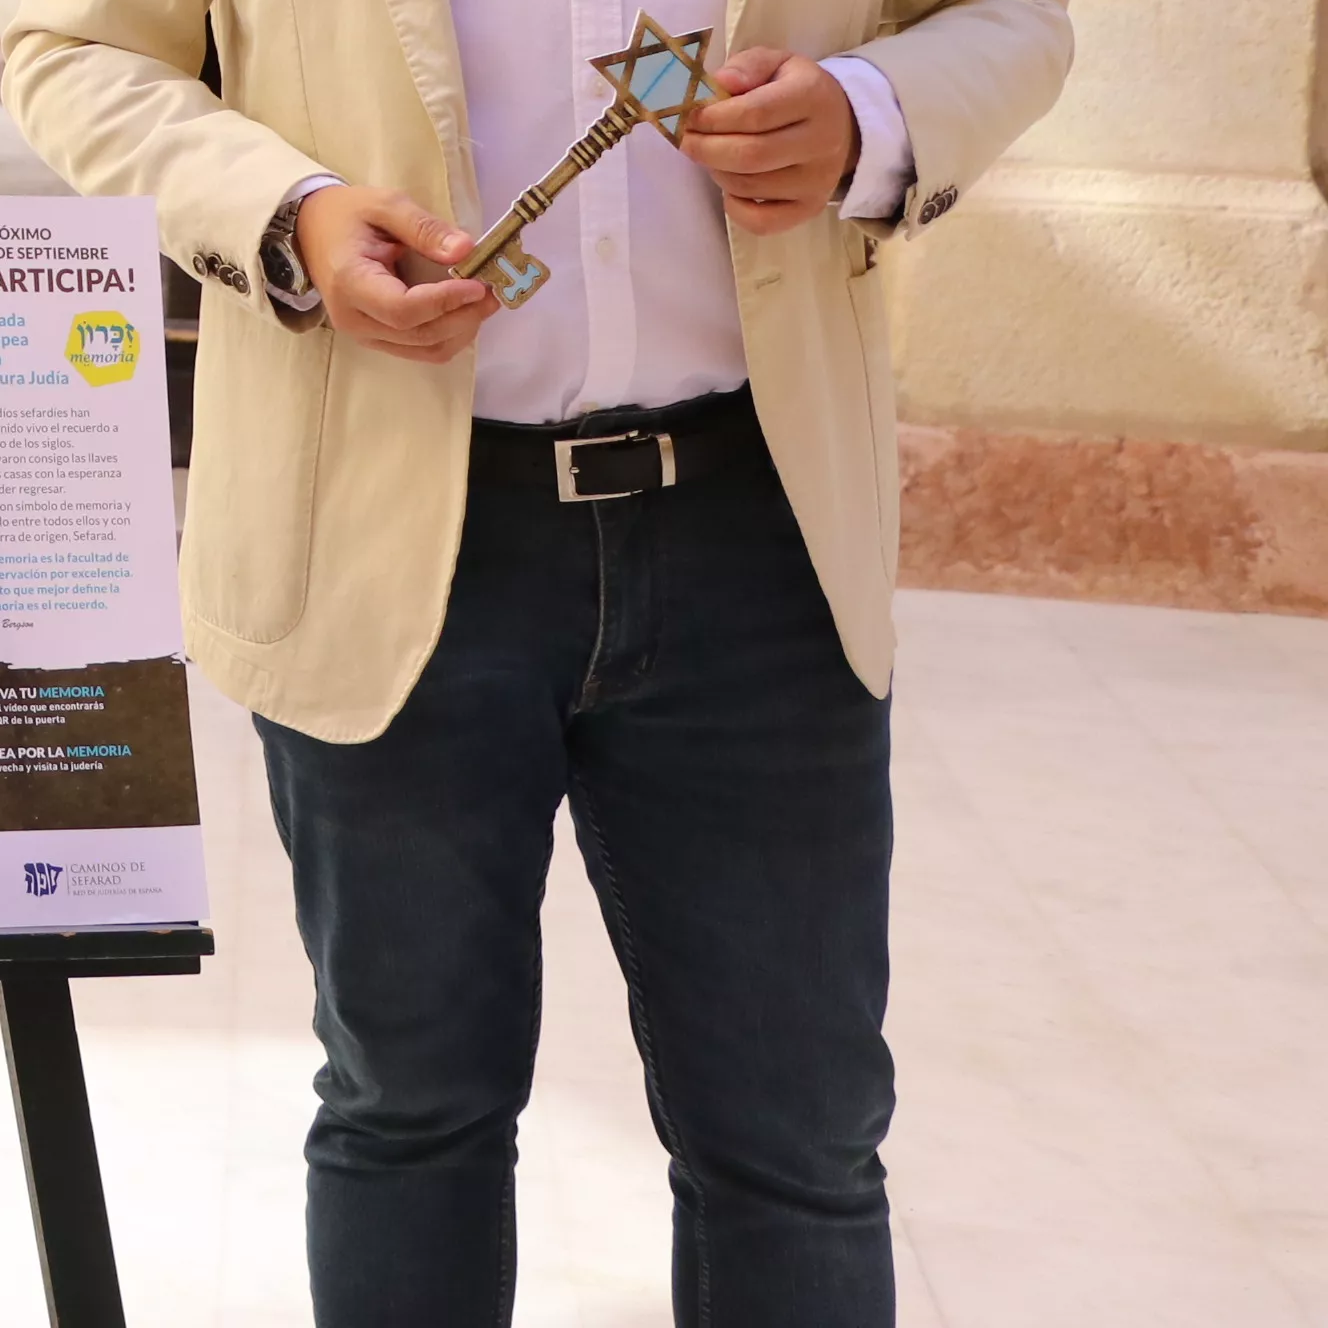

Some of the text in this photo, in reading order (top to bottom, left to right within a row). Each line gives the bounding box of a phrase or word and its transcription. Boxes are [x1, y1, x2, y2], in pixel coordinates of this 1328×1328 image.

[17, 246, 109, 260] SEPTIEMBRE
[70, 352, 134, 366] memoria
[28, 370, 69, 385] Judía
[70, 407, 90, 418] han
[19, 687, 37, 699] TU
[39, 685, 105, 698] MEMORIA
[18, 747, 45, 760] POR
[47, 746, 65, 759] LA
[67, 744, 132, 757] MEMORIA
